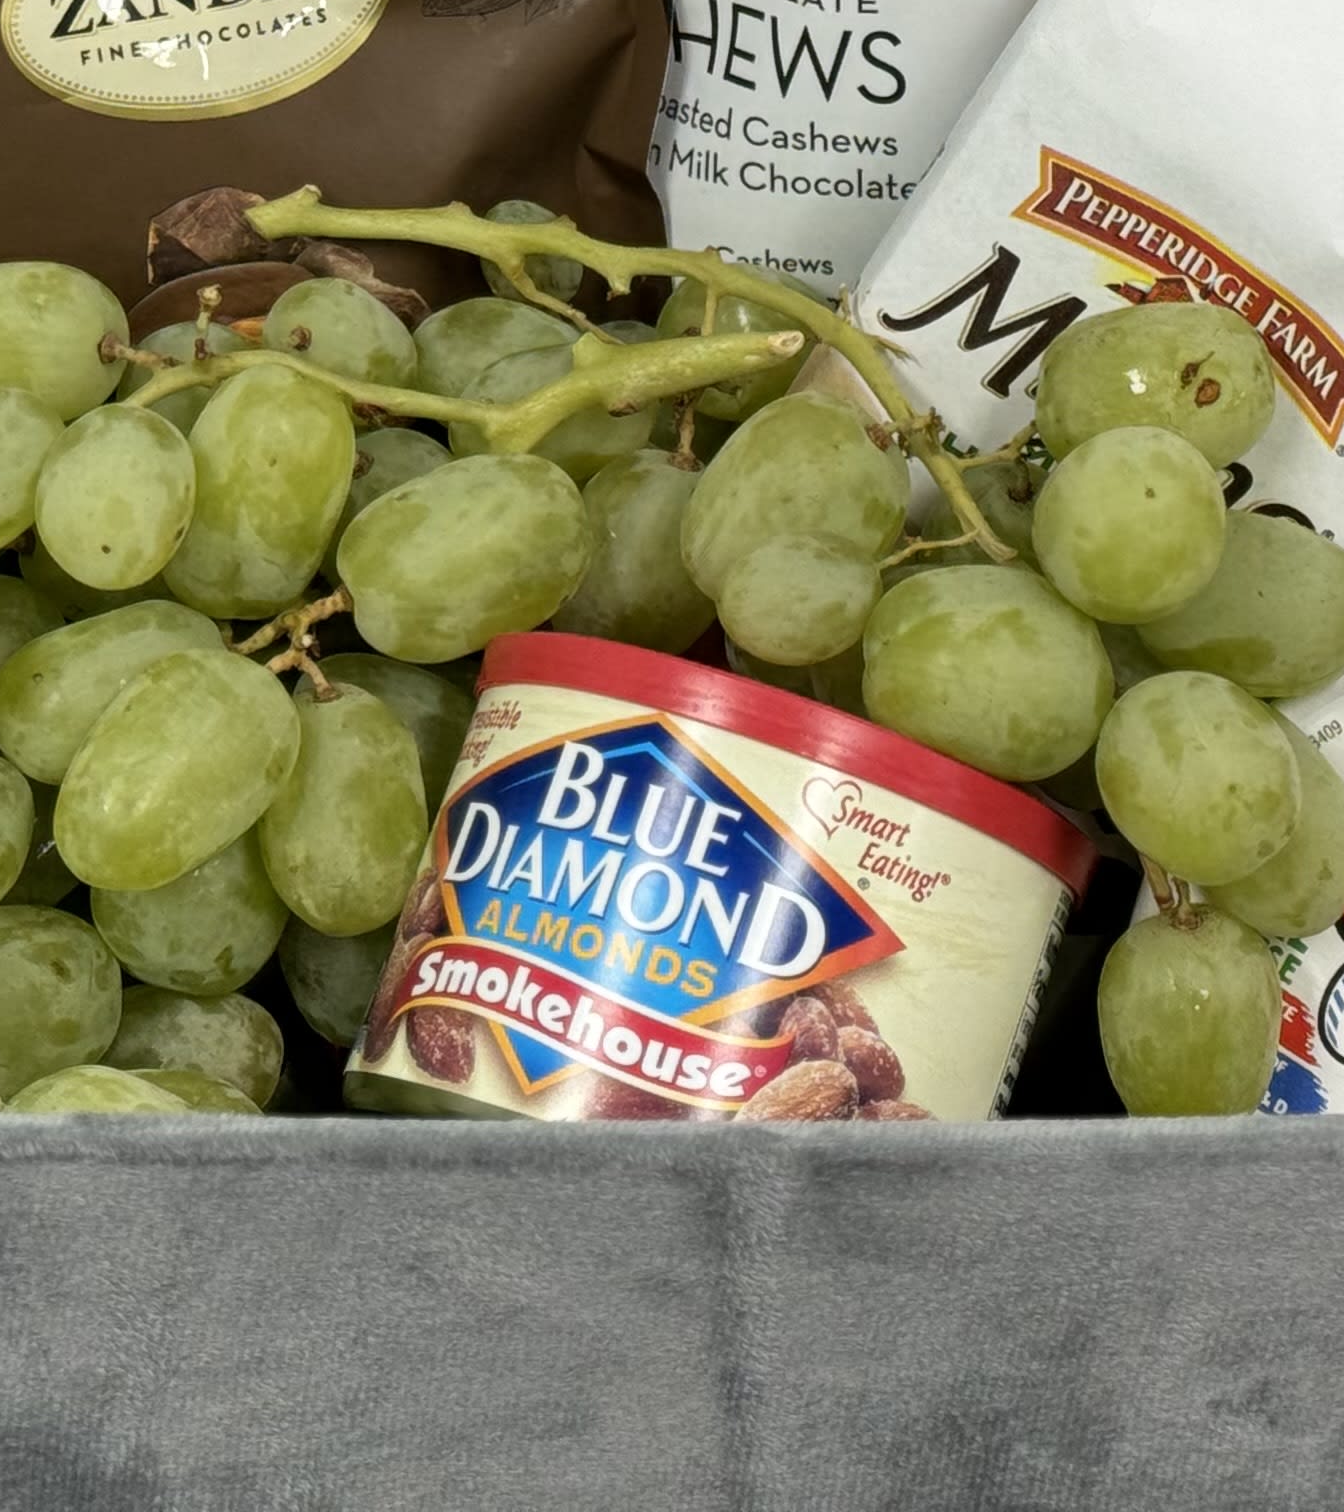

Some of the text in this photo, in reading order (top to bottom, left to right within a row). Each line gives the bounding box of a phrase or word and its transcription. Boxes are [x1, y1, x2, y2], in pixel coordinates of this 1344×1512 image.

[80, 41, 141, 66] FINE
[660, 95, 898, 157] asted Cashews
[669, 140, 729, 187] Milk
[740, 162, 917, 201] Chocolate
[1054, 177, 1341, 400] PEPPERIDGE FARM
[537, 739, 742, 877] BLUE
[831, 795, 911, 848] Smart
[443, 801, 827, 978] DIAMOND
[857, 841, 941, 903] Eating!
[475, 899, 719, 998] ALMONDS
[410, 951, 755, 1097] Smokehouse
